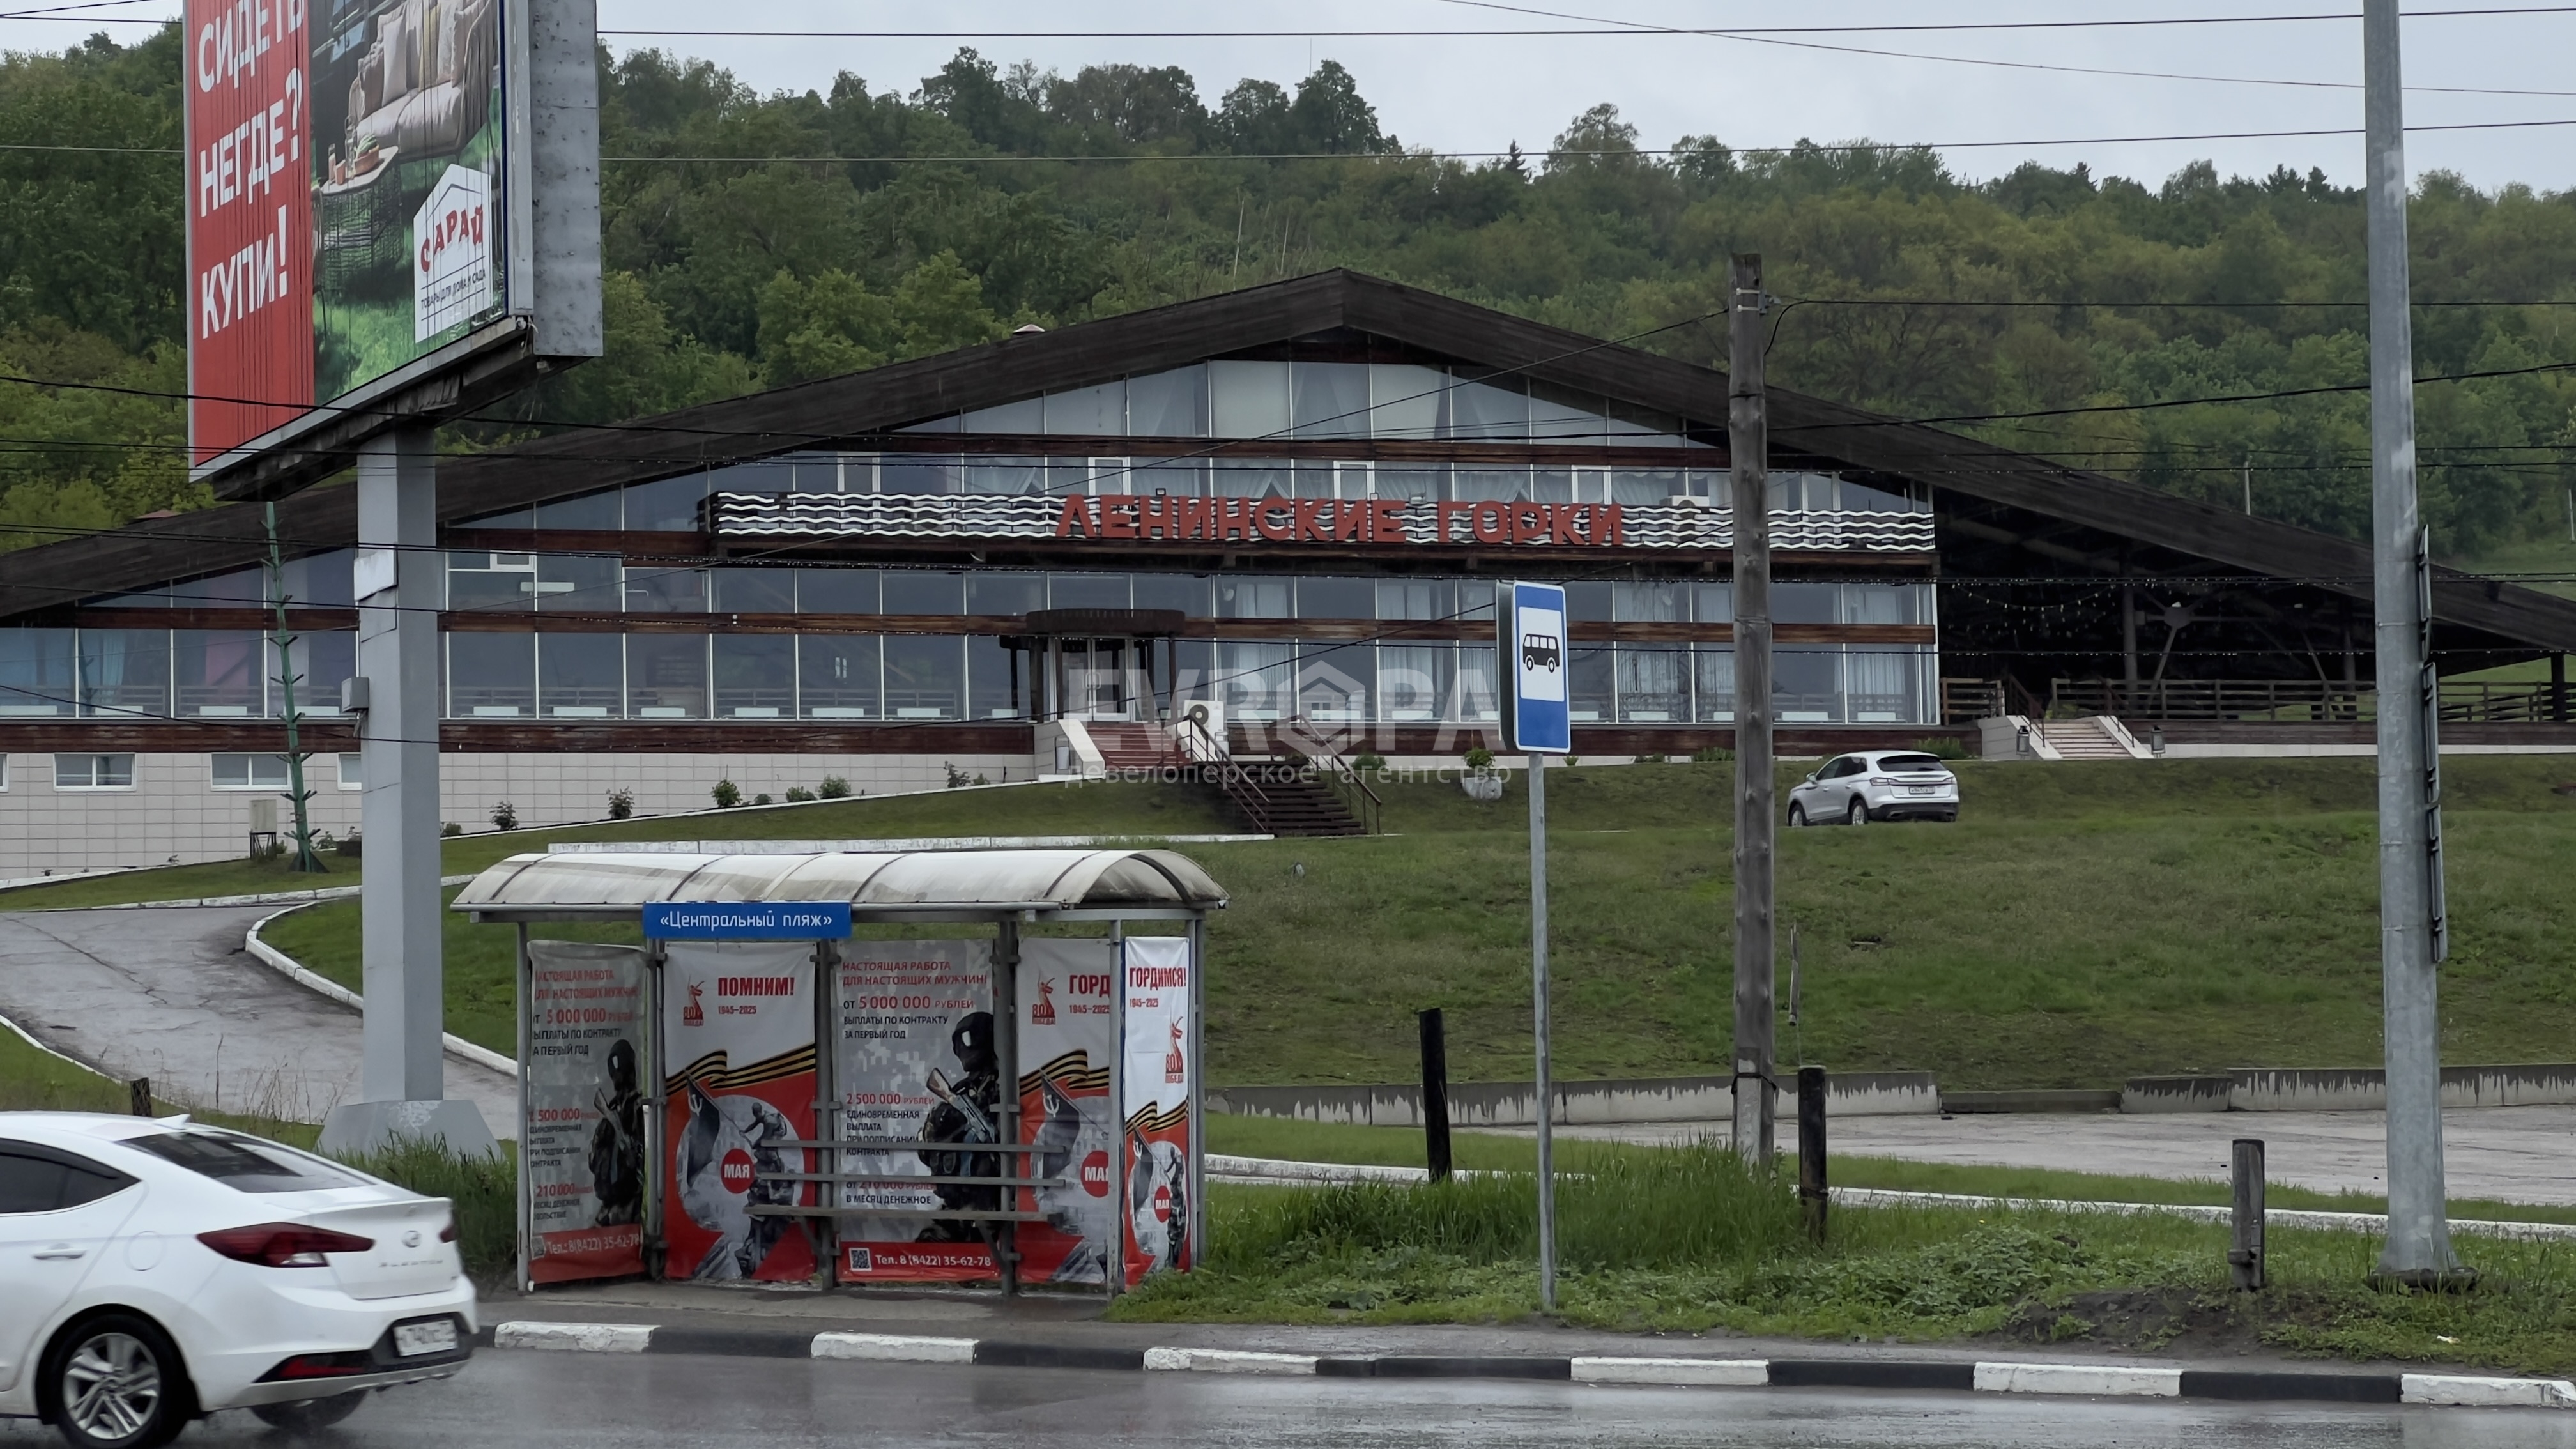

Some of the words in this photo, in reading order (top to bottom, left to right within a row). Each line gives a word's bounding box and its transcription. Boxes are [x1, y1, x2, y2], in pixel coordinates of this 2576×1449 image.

[201, 68, 303, 217] НЕГДЕ?
[420, 204, 484, 272] САРАЙ
[202, 204, 288, 339] КУПИ!
[1056, 494, 1406, 543] ЛЕНИНСКИЕ
[1439, 500, 1624, 546] ГОРКИ
[660, 910, 774, 931] «Центральный
[783, 914, 832, 927] пляж»
[843, 962, 907, 972] НАСТОЯЩАЯ
[910, 962, 951, 970] РАБОТА
[585, 970, 615, 981] РАБОТА
[843, 976, 861, 986] ДЛЯ
[865, 976, 931, 986] НАСТОЯЩИХ
[1130, 967, 1186, 990] ГОРДИМСЯ!
[718, 977, 794, 997] ПОМНИМ!
[1070, 975, 1110, 997] ГОРД
[935, 999, 974, 1008] РУБЛЕЙ
[844, 1016, 882, 1025] ВЫПЛАТЫ
[885, 1016, 896, 1025] ПО
[900, 1016, 948, 1024] КОНТРАКТУ
[534, 1030, 569, 1040] ЫПЛАТЫ
[571, 1030, 581, 1039] ПО
[845, 1031, 853, 1039] ЗА
[855, 1029, 887, 1039] ПЕРВЫЙ
[890, 1031, 906, 1039] ГОД
[575, 1045, 589, 1056] ГОД
[847, 1093, 852, 1104] 2
[847, 1110, 919, 1119] ЕДИНОВРЕМЕННАЯ
[724, 1164, 750, 1179] МАЯ
[854, 1195, 882, 1205] МЕСЯЦ
[884, 1195, 931, 1205] ДЕНЕЖНОЕ
[875, 1255, 897, 1264] Тел.
[944, 1256, 992, 1266] 35-62-78
